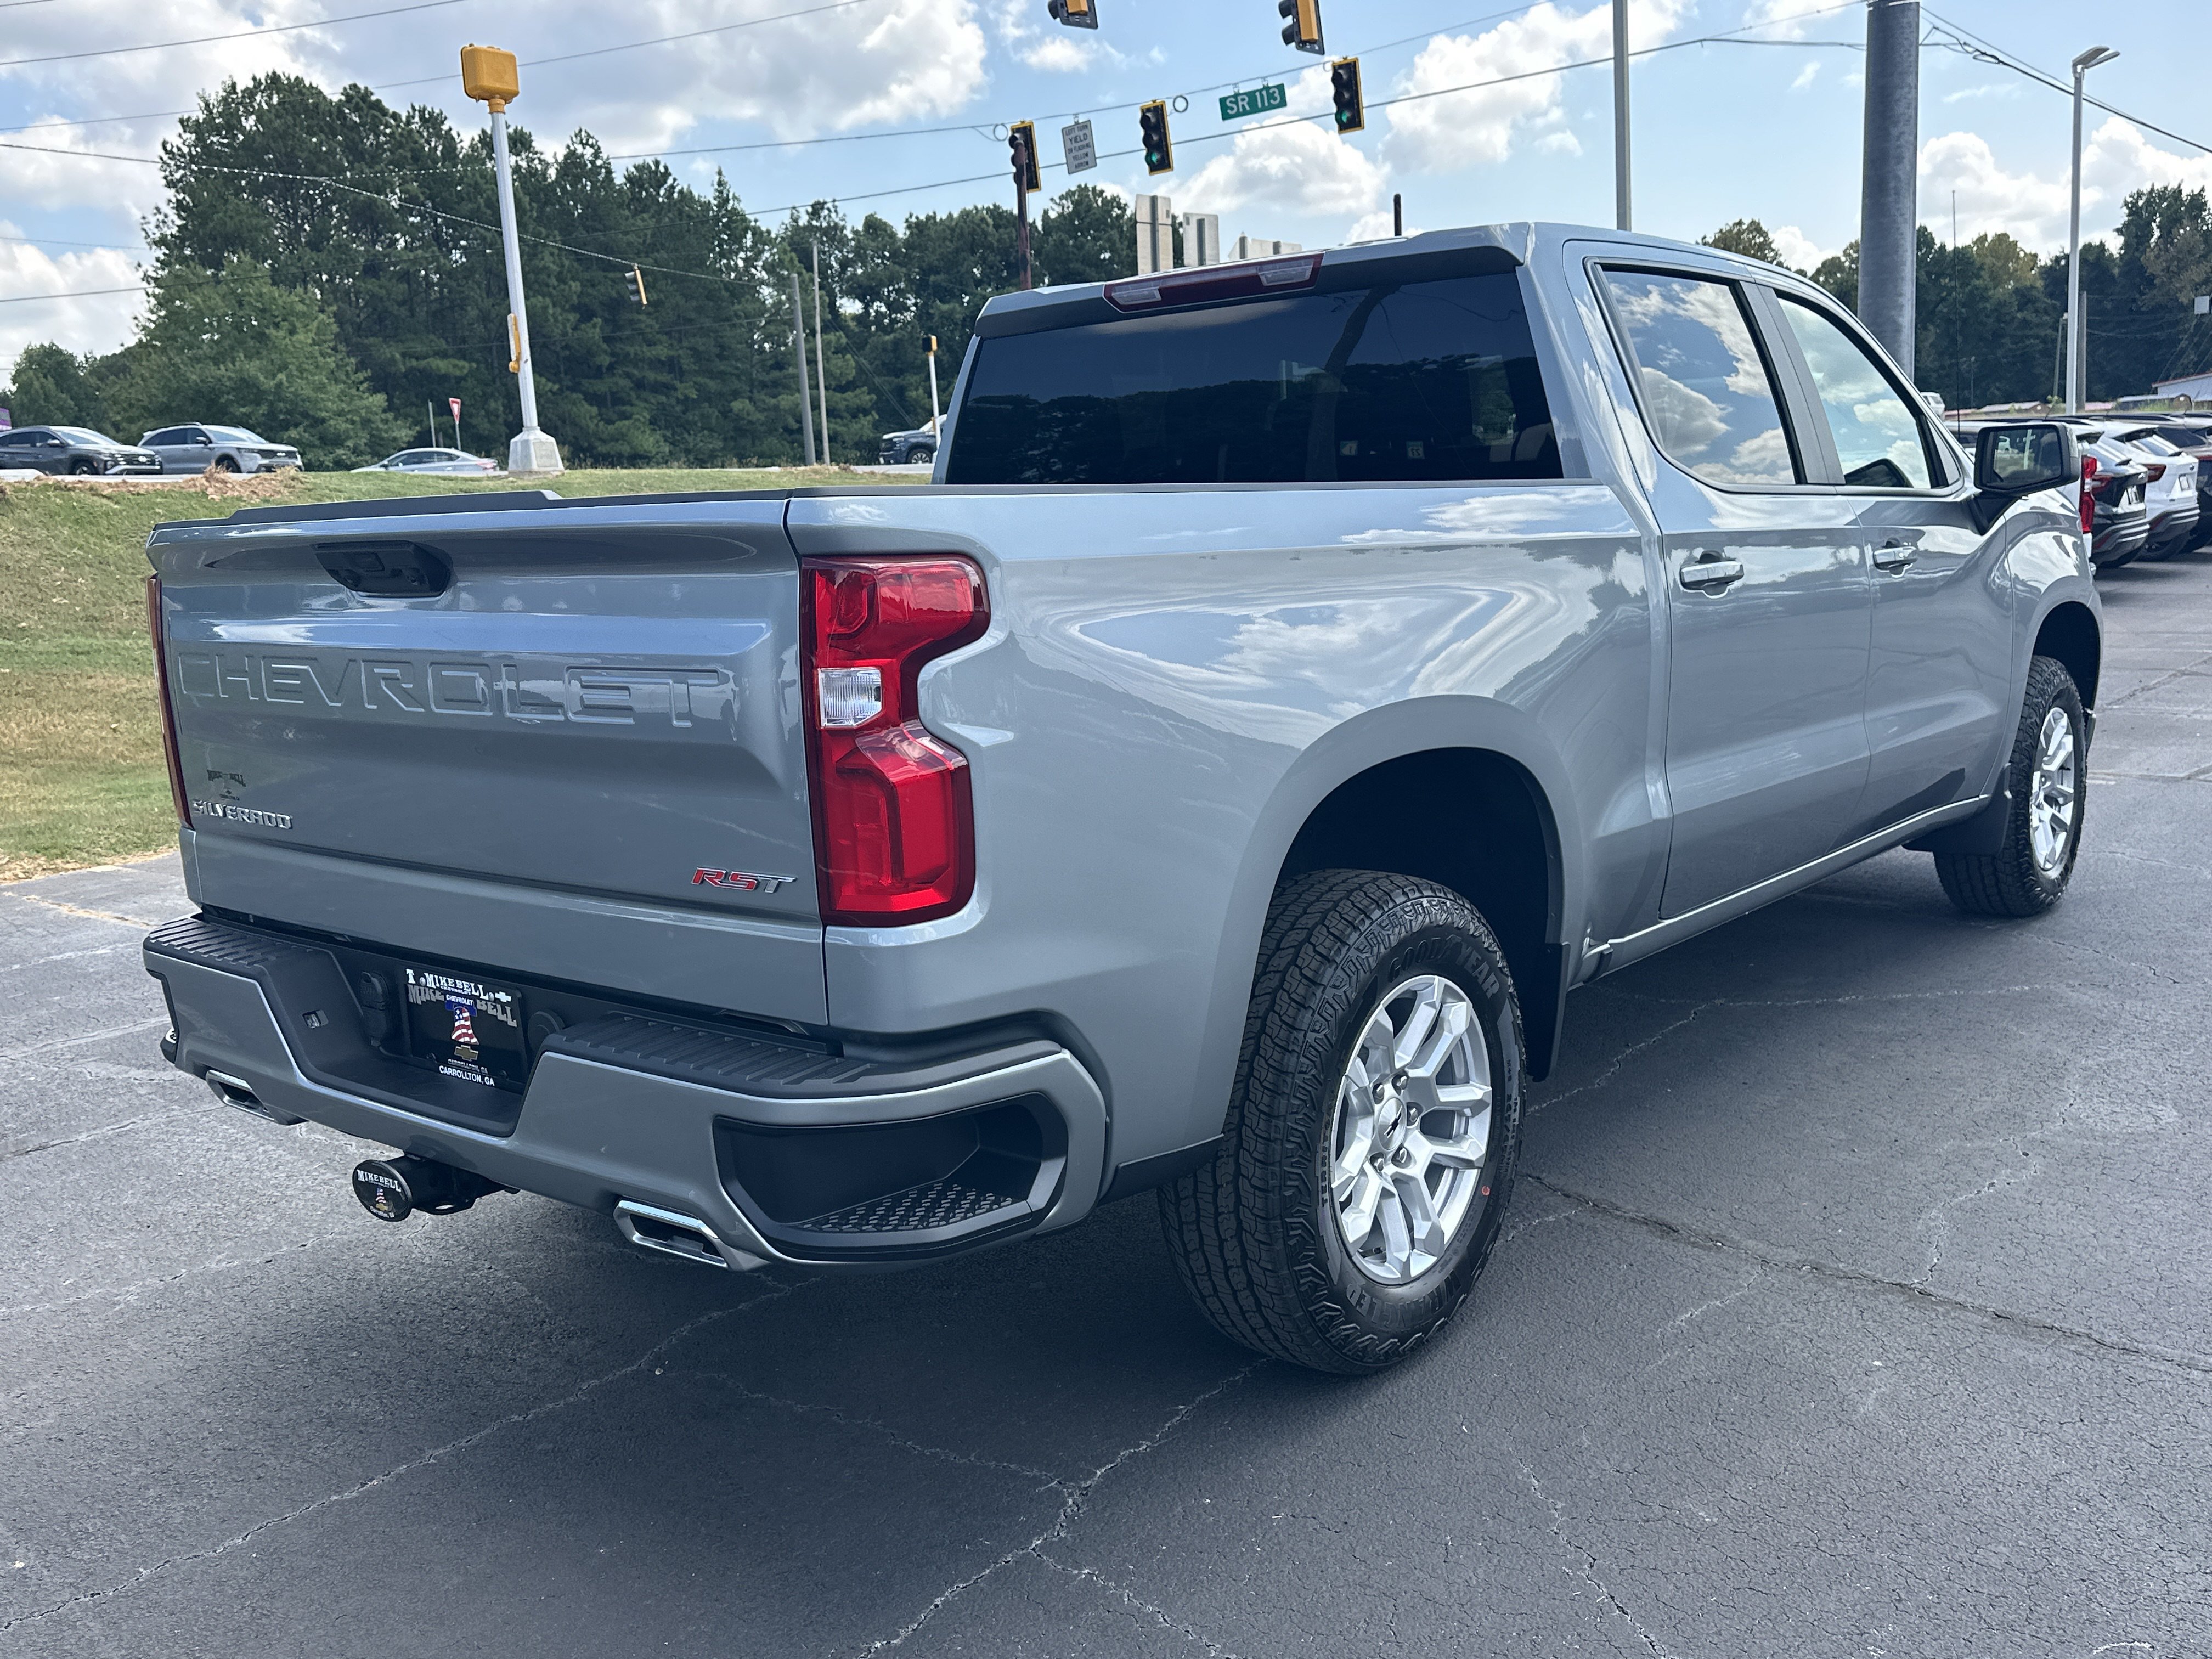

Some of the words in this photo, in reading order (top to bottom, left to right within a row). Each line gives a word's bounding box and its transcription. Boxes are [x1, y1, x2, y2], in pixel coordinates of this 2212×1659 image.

[1226, 95, 1250, 114] SR
[1255, 88, 1280, 108] 113
[1069, 133, 1088, 144] YIELD
[179, 653, 719, 727] CHEVROLET
[192, 799, 293, 830] SILVERADO
[691, 866, 797, 893] RST
[1387, 934, 1500, 999] GOODYEAR
[424, 973, 455, 989] MIKE
[455, 979, 489, 1000] BELL
[445, 994, 474, 1006] CHEVROLET
[408, 984, 445, 1005] MIKE
[476, 999, 517, 1028] BELL
[439, 1065, 484, 1085] CARROLLTON,
[484, 1076, 495, 1086] GA
[357, 1169, 379, 1182] MIKE
[379, 1176, 402, 1192] BELL
